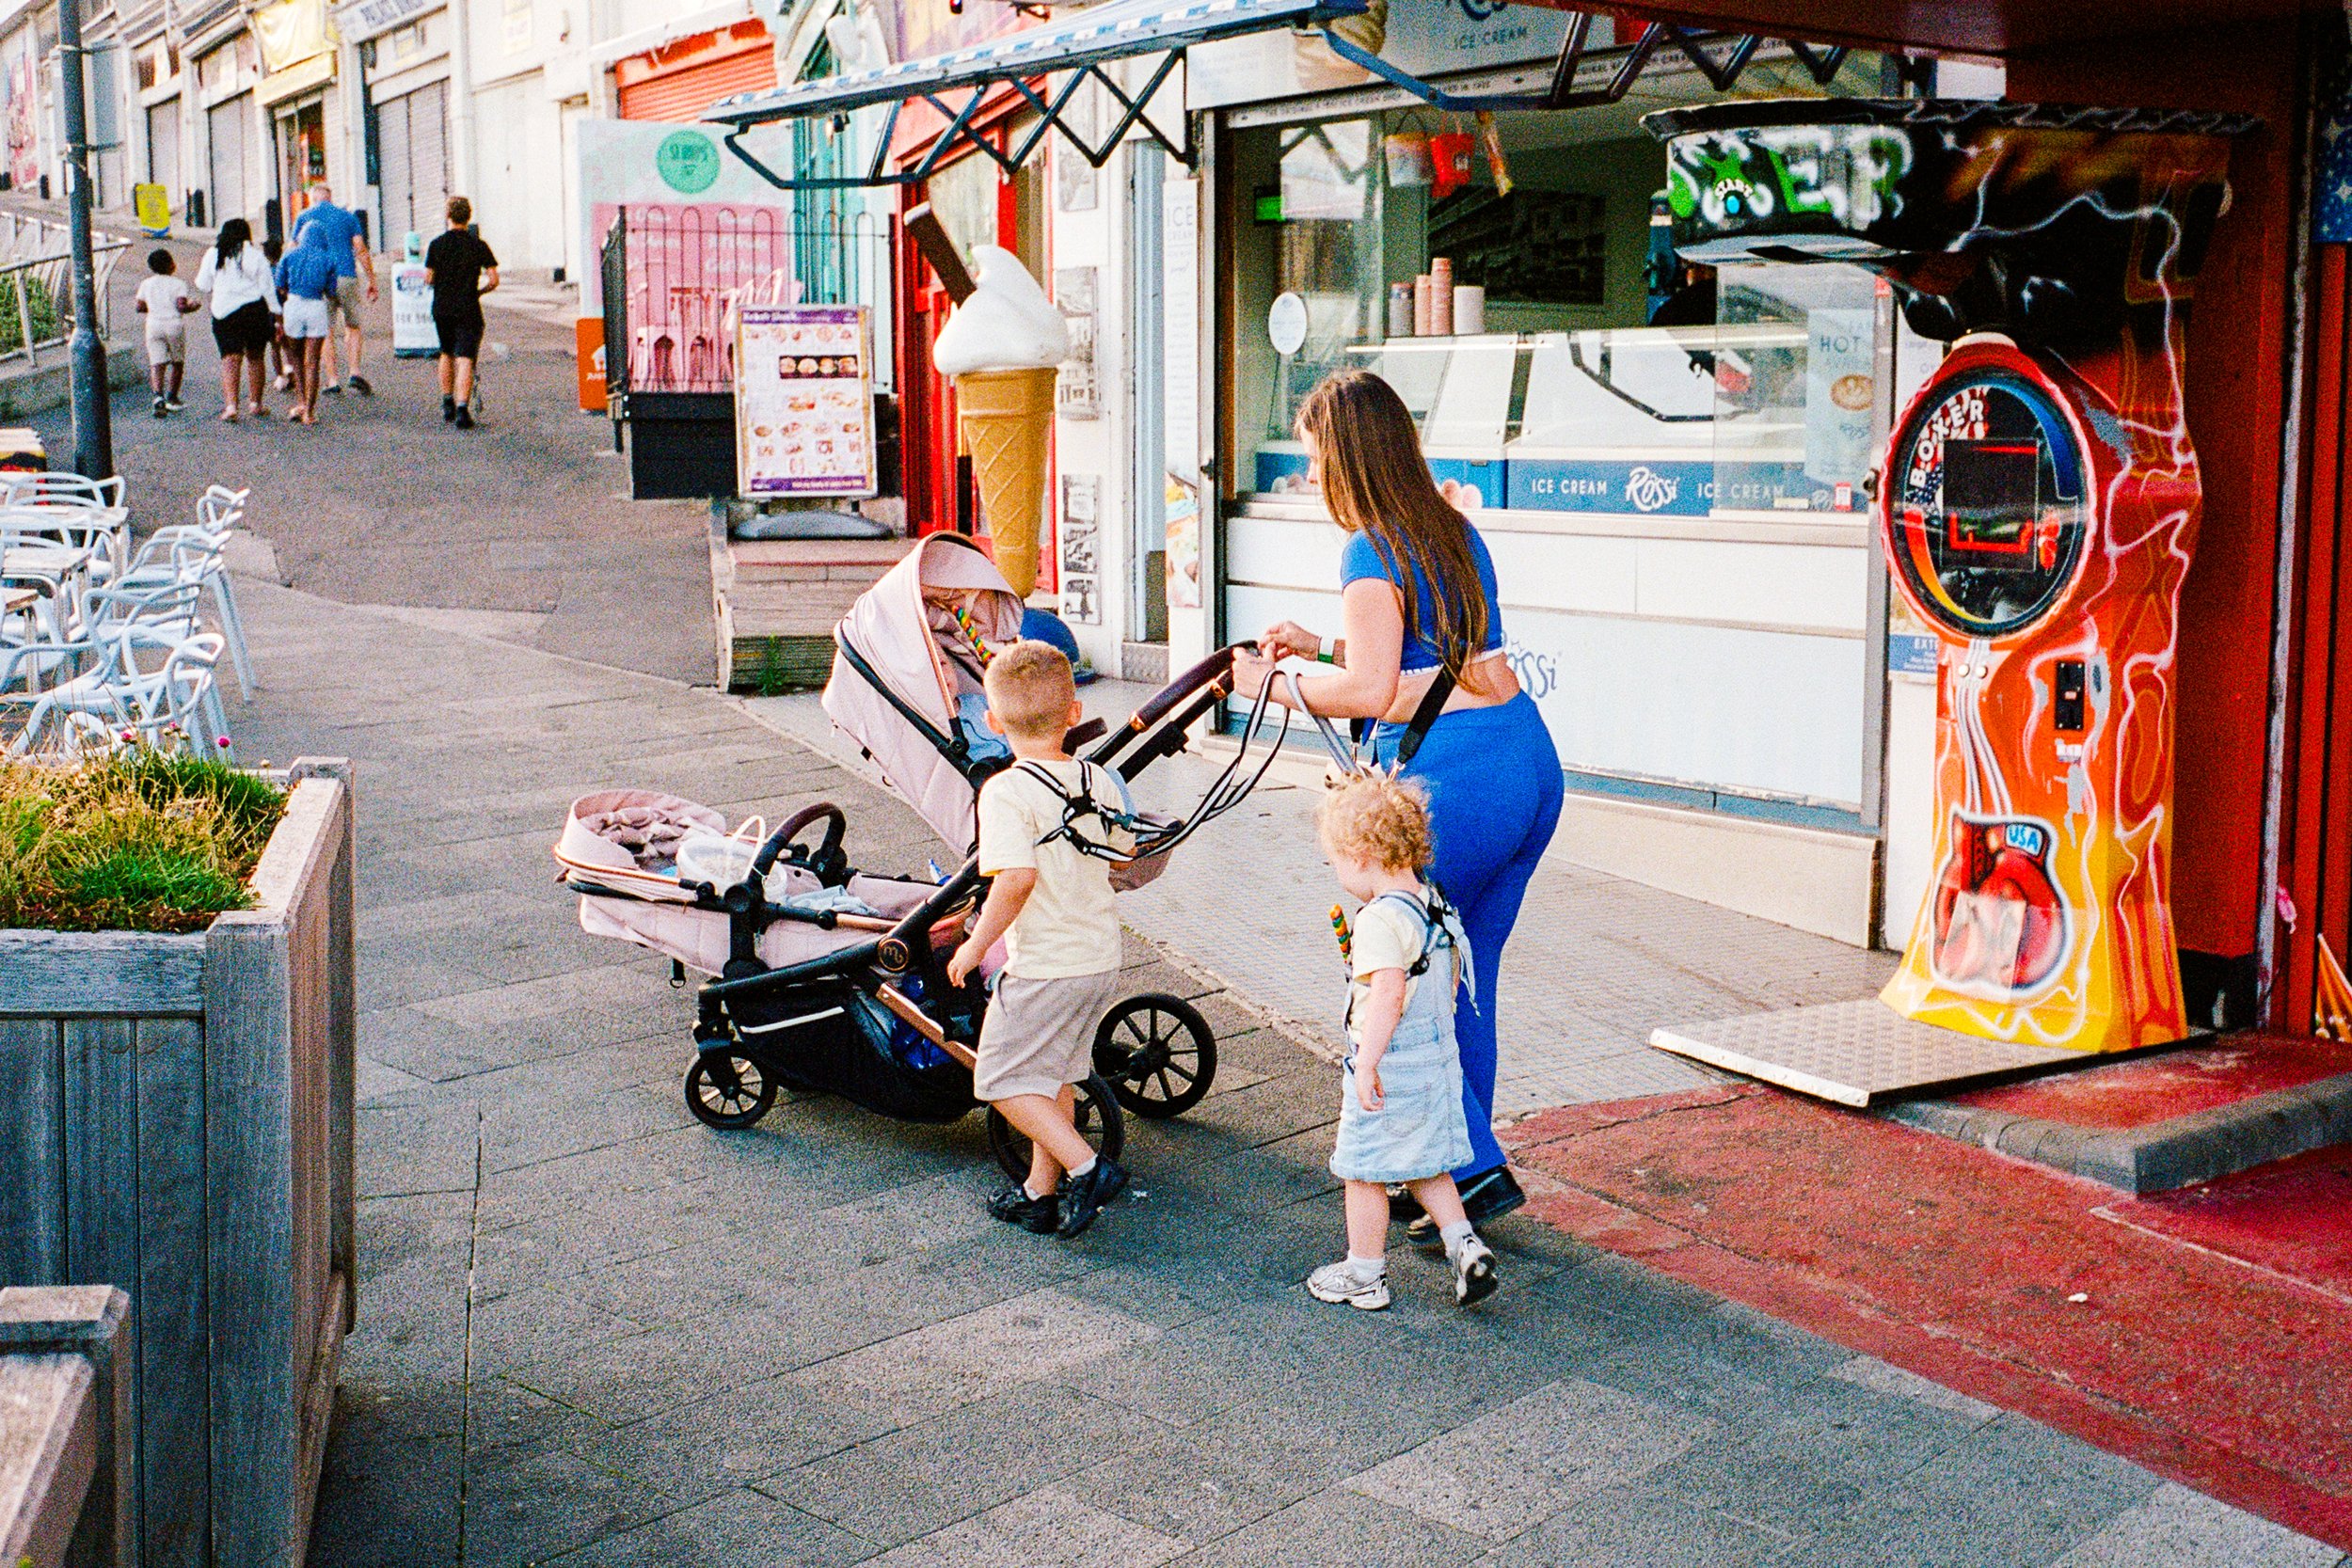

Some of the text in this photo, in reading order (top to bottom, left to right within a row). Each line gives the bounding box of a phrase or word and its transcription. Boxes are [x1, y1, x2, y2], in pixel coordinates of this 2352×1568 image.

[1481, 25, 1528, 45] CREAM
[1714, 179, 1753, 200] START
[1167, 205, 1194, 227] ICE
[1820, 336, 1861, 354] HOT
[1532, 478, 1554, 495] ICE
[1561, 479, 1608, 497] CREAM
[1697, 483, 1723, 499] ICE
[1731, 483, 1784, 501] CREAM
[2009, 824, 2041, 852] USA
